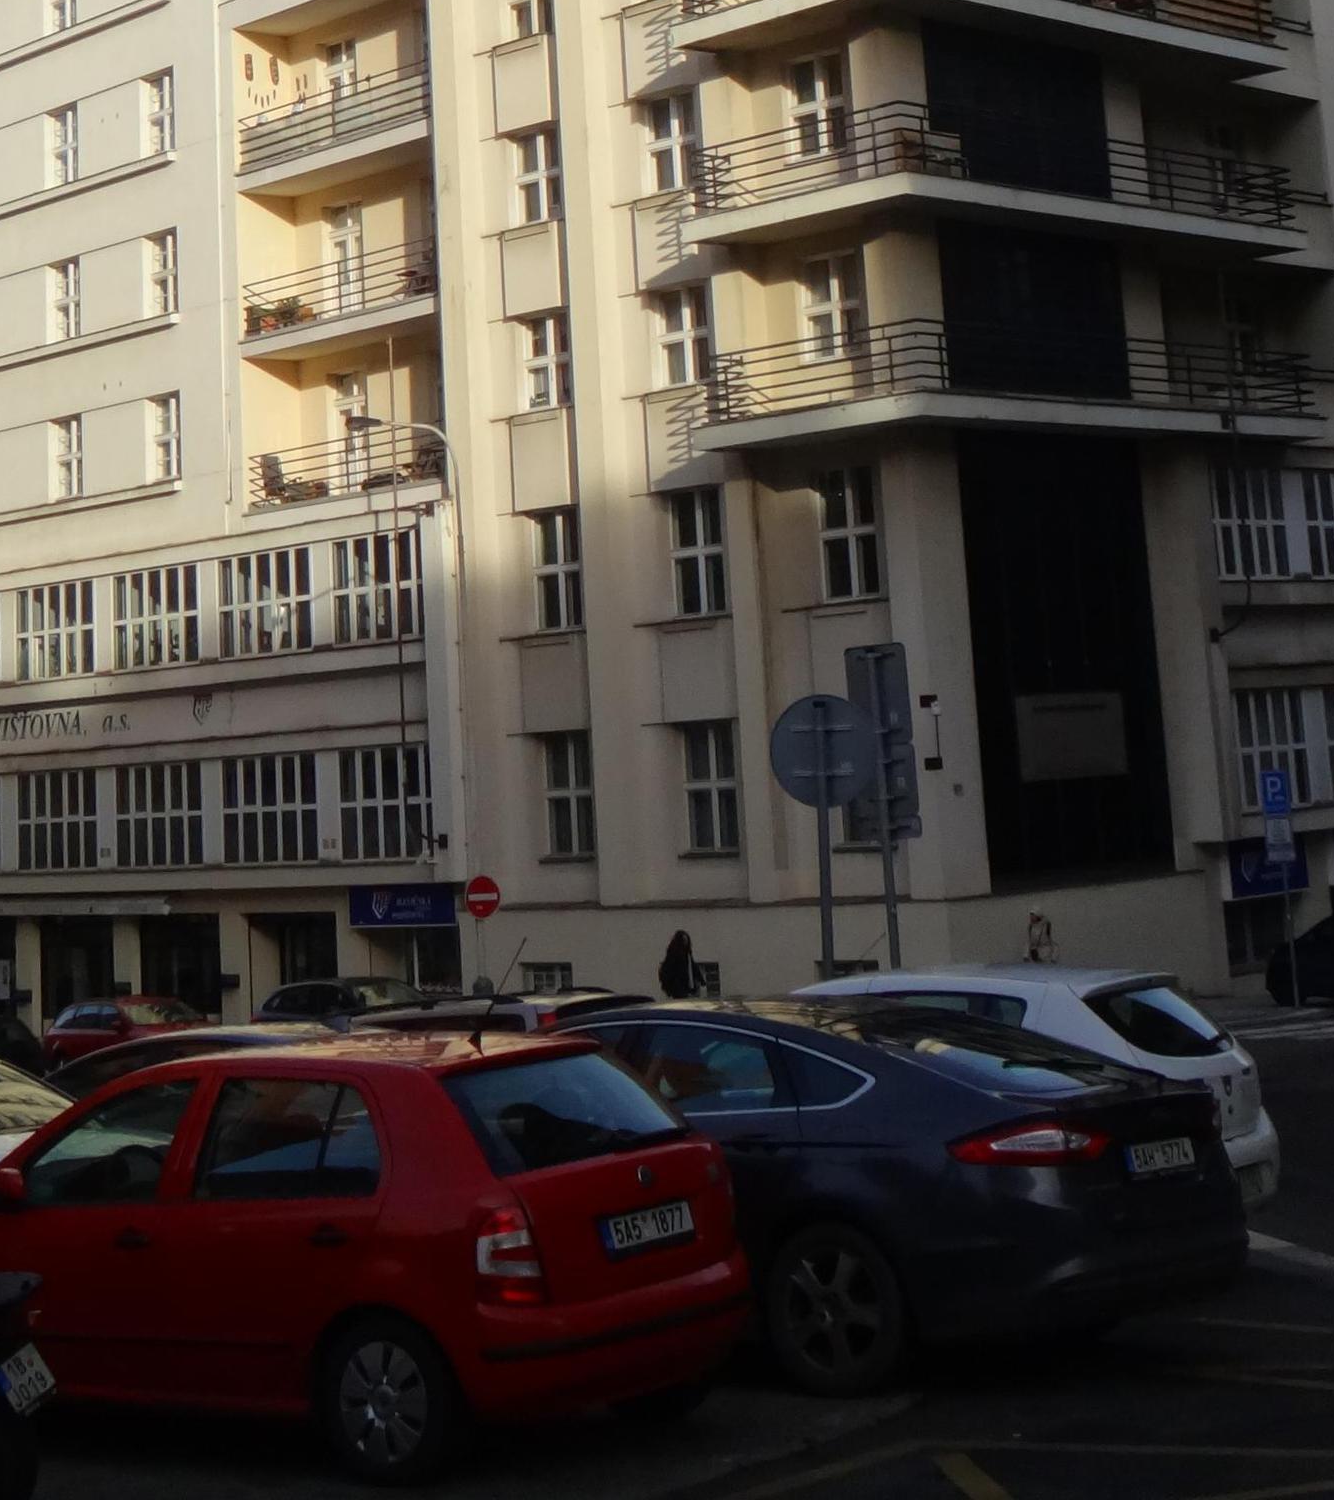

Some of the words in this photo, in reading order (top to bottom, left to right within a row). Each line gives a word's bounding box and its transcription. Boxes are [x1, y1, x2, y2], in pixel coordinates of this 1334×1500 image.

[102, 712, 132, 733] a.s.
[1267, 776, 1281, 801] P
[613, 1217, 642, 1244] 5A5
[651, 1206, 683, 1234] 1877
